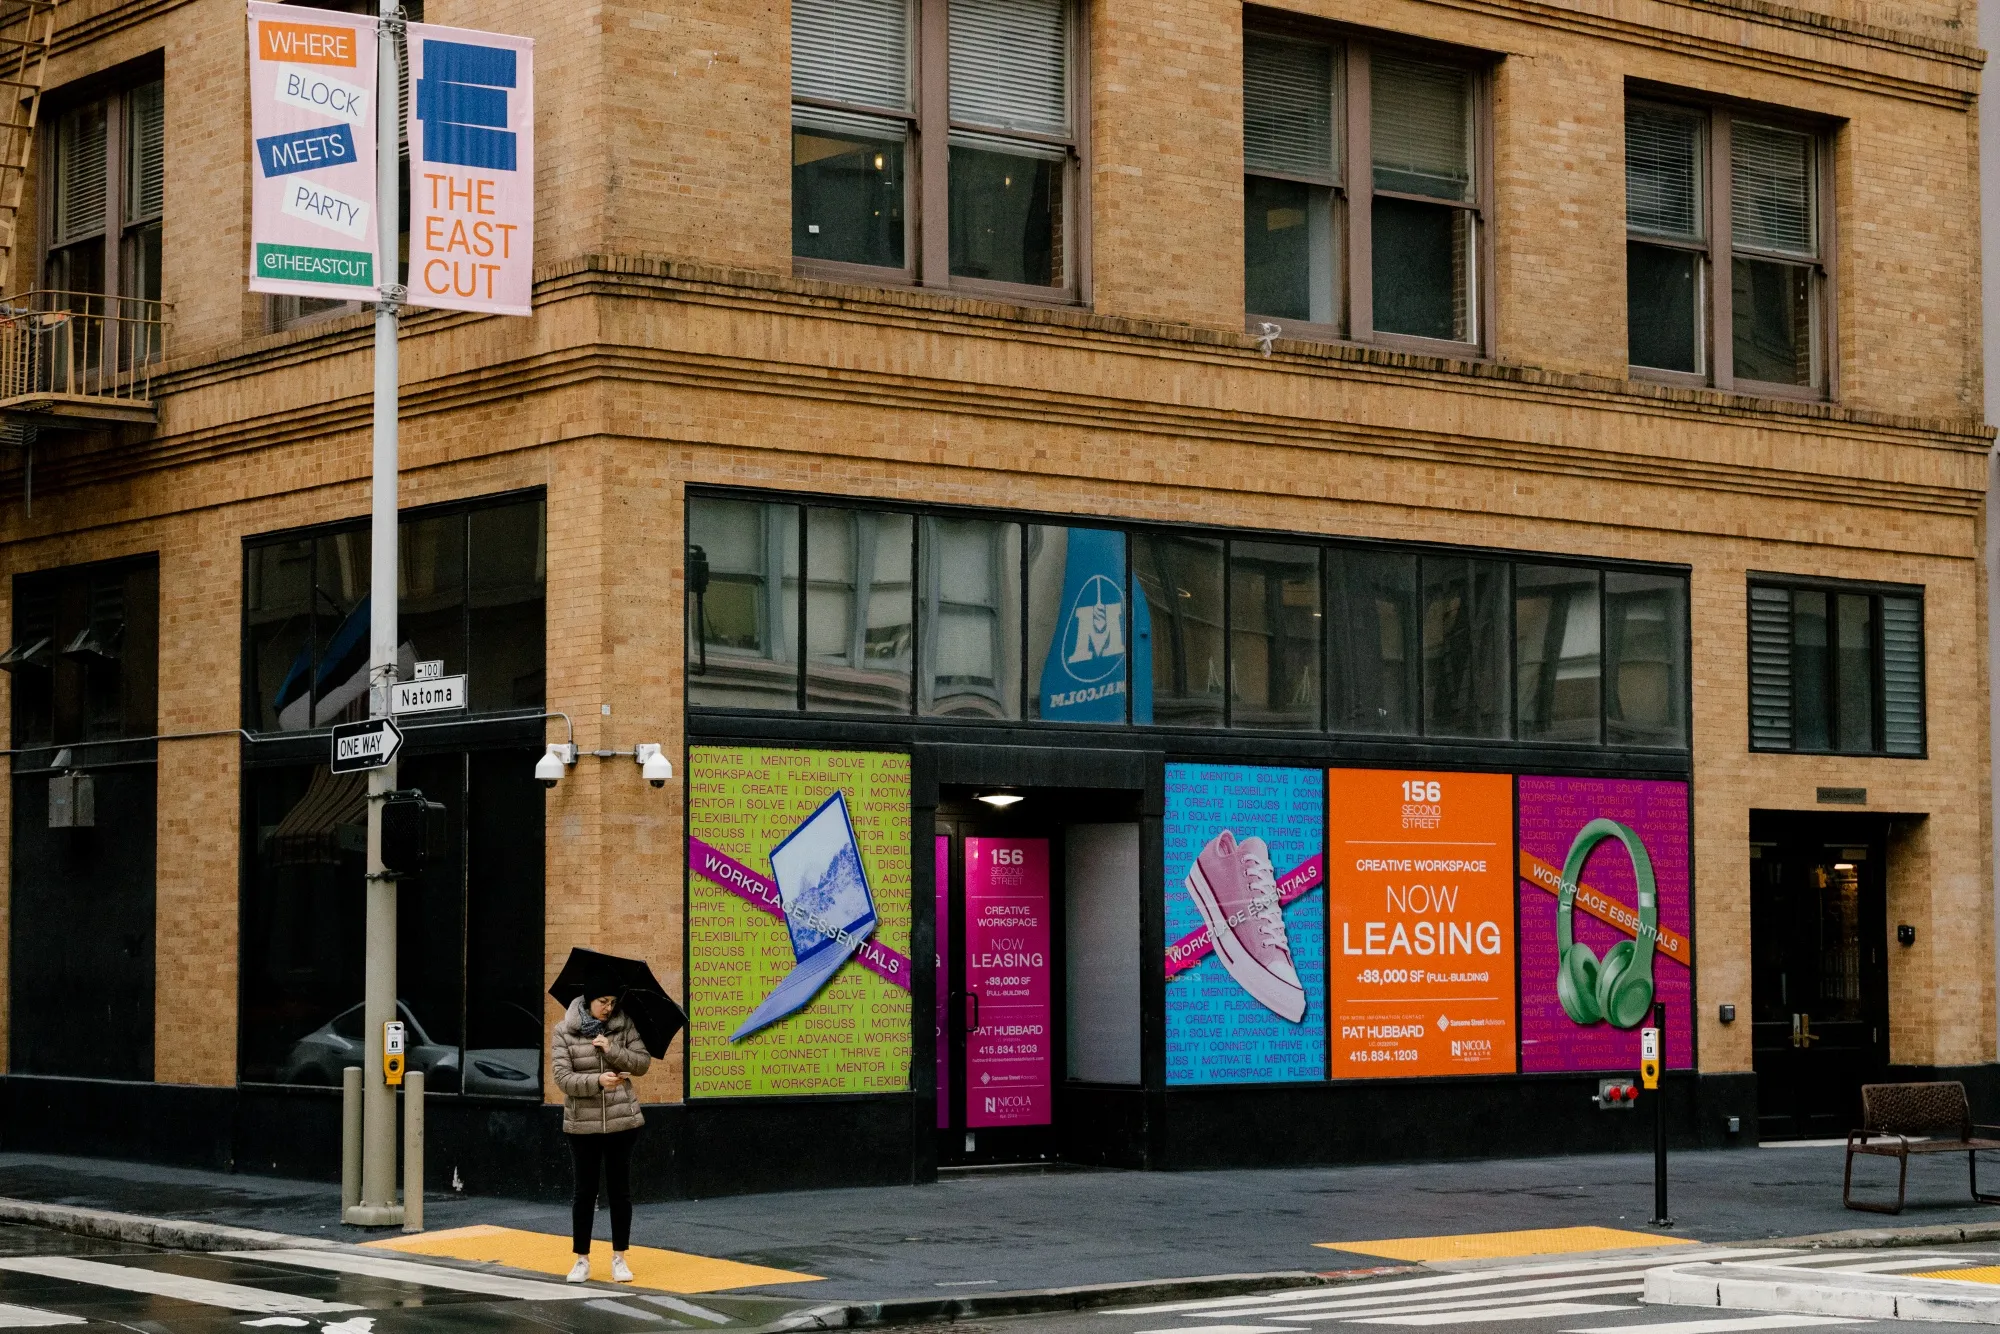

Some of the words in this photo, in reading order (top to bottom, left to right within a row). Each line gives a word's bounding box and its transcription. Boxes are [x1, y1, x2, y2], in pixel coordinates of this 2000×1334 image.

[268, 30, 349, 59] WHERE
[287, 73, 360, 116] BLOCK
[272, 134, 345, 168] MEETS
[424, 173, 495, 215] THE
[295, 186, 359, 226] PARTY
[426, 217, 517, 258] EAST
[264, 253, 367, 278] @THEEASTCUT
[424, 259, 500, 299] CUT
[424, 664, 438, 676] 100
[402, 687, 452, 706] Natoma
[340, 738, 359, 757] ONE
[362, 734, 382, 753] WAY
[761, 756, 811, 766] MENTOR
[828, 758, 865, 768] SOLVE
[693, 769, 770, 779] WORKSPACE
[788, 771, 853, 782] FLEXIBILITY
[1200, 772, 1242, 781] MENTOR
[1257, 774, 1288, 784] SOLVE
[742, 785, 788, 795] CREATE
[1223, 785, 1278, 796] FLEXIBILITY
[1401, 780, 1441, 802] 156
[747, 799, 784, 809] SOLVE
[1184, 797, 1224, 808] CREATE
[1238, 799, 1280, 810] DISCUSS
[1401, 804, 1441, 815] SECOND
[691, 813, 758, 823] FLEXIBILITY
[1189, 811, 1221, 821] SOLVE
[1231, 812, 1277, 823] ADVANCE
[1401, 818, 1441, 829] STREET
[693, 828, 744, 838] DISCUSS
[1268, 827, 1301, 836] THRIVE
[991, 849, 1024, 865] 156
[991, 866, 1023, 875] SECOND
[1356, 859, 1411, 872] CREATIVE
[1414, 860, 1487, 872] WORKSPACE
[991, 877, 1022, 885] STREET
[1387, 885, 1459, 913] NOW
[705, 853, 806, 920] WORKPLACE
[807, 911, 899, 974] ESSENTIALS
[985, 906, 1030, 915] CREATIVE
[1533, 864, 1606, 915] WORKPLACE
[1609, 906, 1678, 952] ESSENTIALS
[977, 918, 1037, 927] WORKSPACE
[691, 932, 758, 941] FLEXIBILITY
[1343, 921, 1501, 955] LEASING
[991, 938, 1024, 950] NOW
[693, 947, 744, 956] DISCUSS
[694, 962, 751, 971] ADVANCE
[972, 953, 1043, 968] LEASING
[1021, 977, 1031, 985] SF
[1356, 969, 1407, 984] +33,000
[1410, 970, 1424, 983] SF
[1427, 971, 1489, 984] (FULL-BUILDING)
[829, 990, 865, 999] SOLVE
[1202, 987, 1244, 996] MENTOR
[805, 1019, 855, 1029] DISCUSS
[1185, 1015, 1224, 1024] CREATE
[973, 1026, 992, 1036] PAT
[994, 1025, 1043, 1035] HUBBARD
[1189, 1028, 1222, 1038] SOLVE
[1232, 1028, 1278, 1038] ADVANCE
[1342, 1026, 1365, 1038] PAT
[1368, 1025, 1424, 1038] HUBBARD
[797, 1034, 853, 1044] ADVANCE
[1462, 1040, 1491, 1050] NICOLA
[979, 1045, 1038, 1054] 415.834.1203
[1210, 1041, 1257, 1051] CONNECT
[1269, 1040, 1302, 1050] THRIVE
[691, 1051, 758, 1061] FLEXIBILITY
[771, 1049, 829, 1059] CONNECT
[841, 1047, 881, 1058] THRIVE
[1202, 1055, 1251, 1064] MOTIVATE
[1264, 1053, 1306, 1063] MENTOR
[1350, 1050, 1418, 1061] 415.834.1203
[693, 1066, 745, 1076] DISCUSS
[761, 1064, 820, 1074] MOTIVATE
[836, 1062, 885, 1072] MENTOR
[1210, 1067, 1272, 1078] WORKSPACE
[694, 1080, 752, 1091] ADVANCE
[771, 1078, 845, 1088] WORKSPACE
[997, 1096, 1032, 1107] NICOLA
